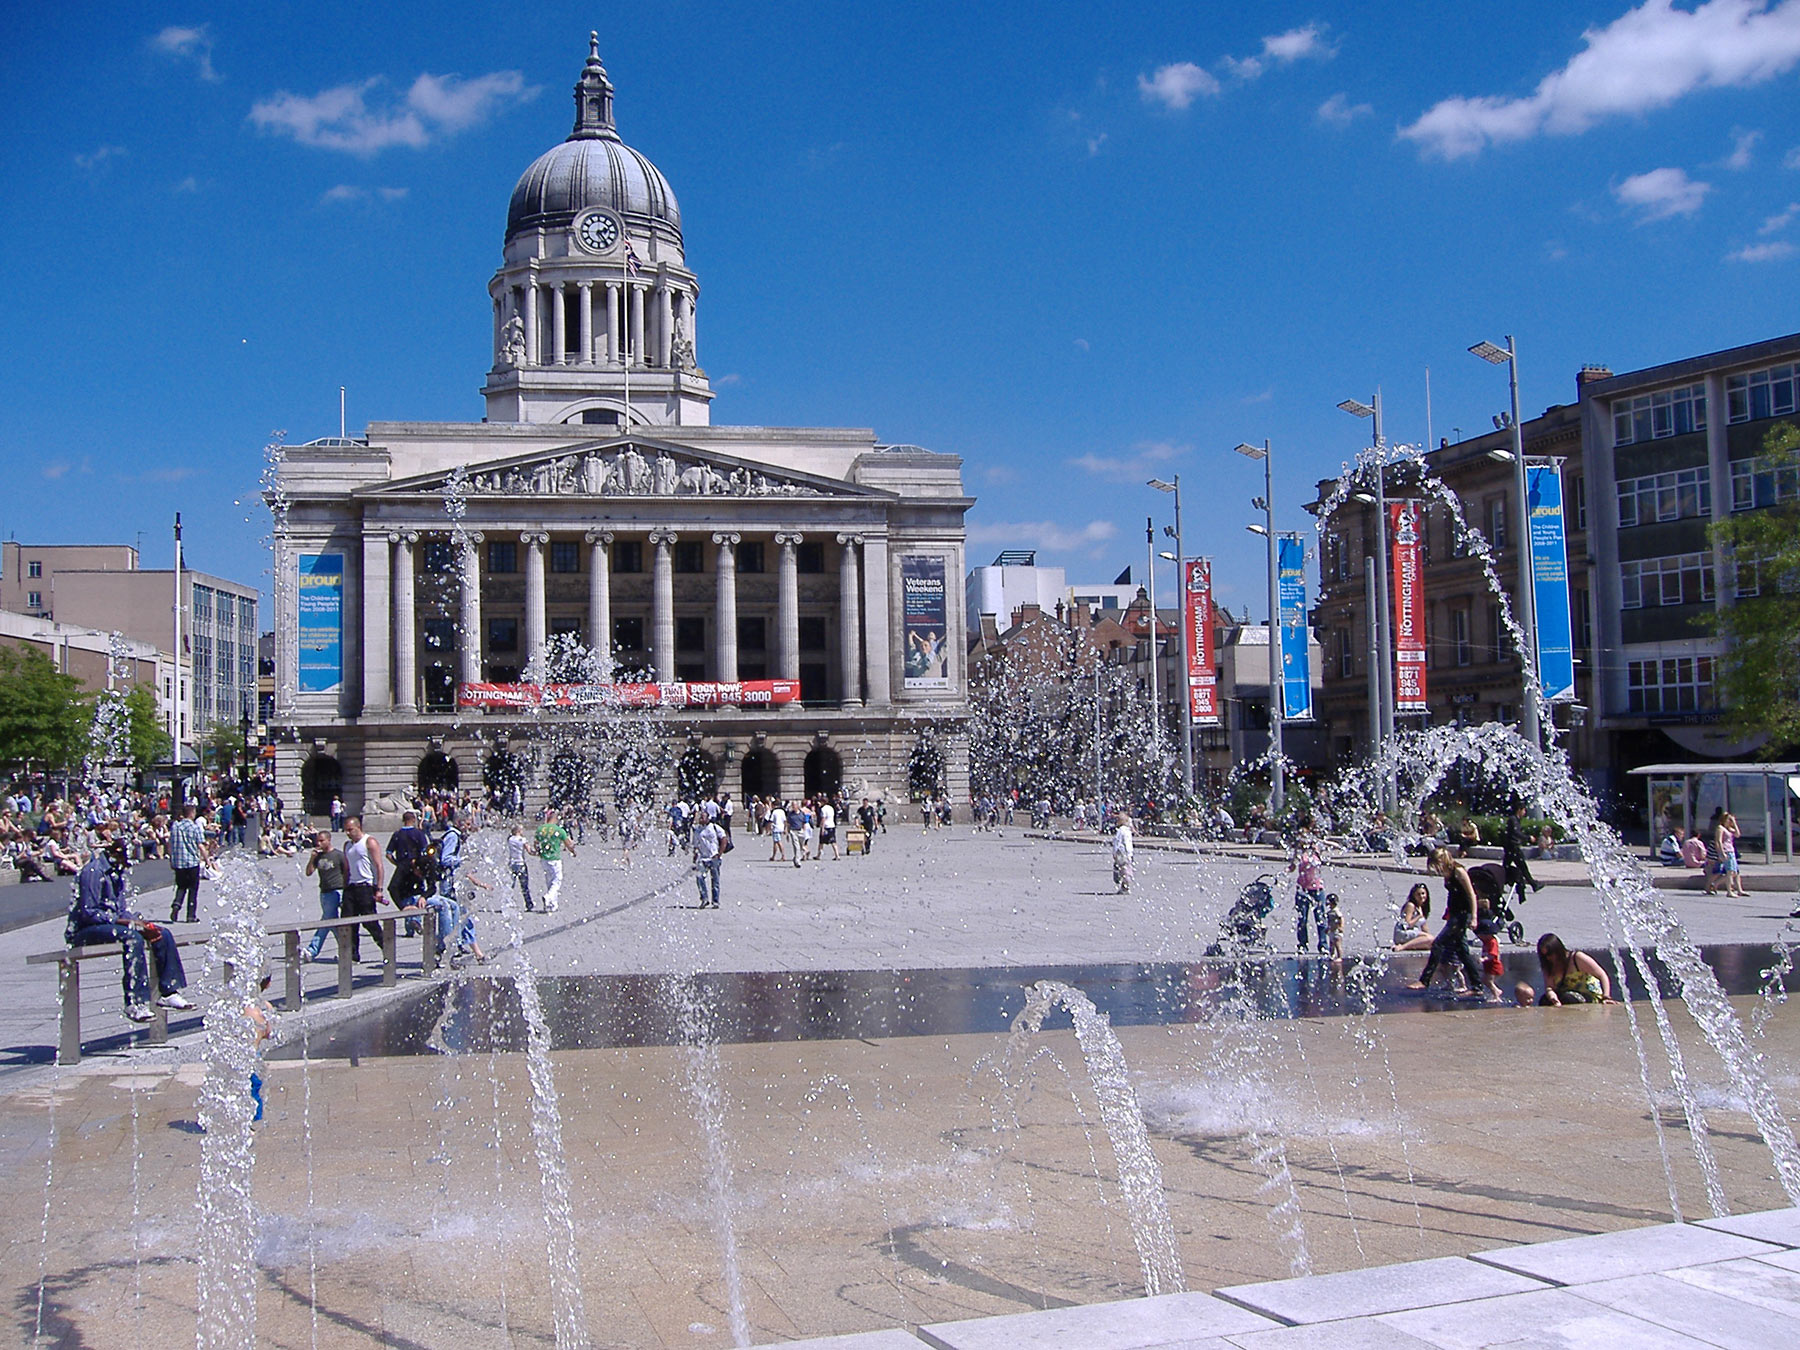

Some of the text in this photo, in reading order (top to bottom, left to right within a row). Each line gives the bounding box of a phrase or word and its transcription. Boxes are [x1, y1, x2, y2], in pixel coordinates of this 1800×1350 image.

[300, 573, 341, 588] proud
[905, 578, 941, 586] Veterans
[905, 585, 943, 593] Weekend
[1402, 562, 1413, 637] NOTTINGHAM
[1195, 606, 1205, 665] NOTTINGHAM
[1399, 671, 1418, 679] 0871
[690, 682, 743, 693] BOOK NOW:
[1401, 679, 1417, 687] 945
[721, 692, 742, 702] 945
[744, 691, 772, 702] 3000
[1399, 687, 1420, 696] 3000
